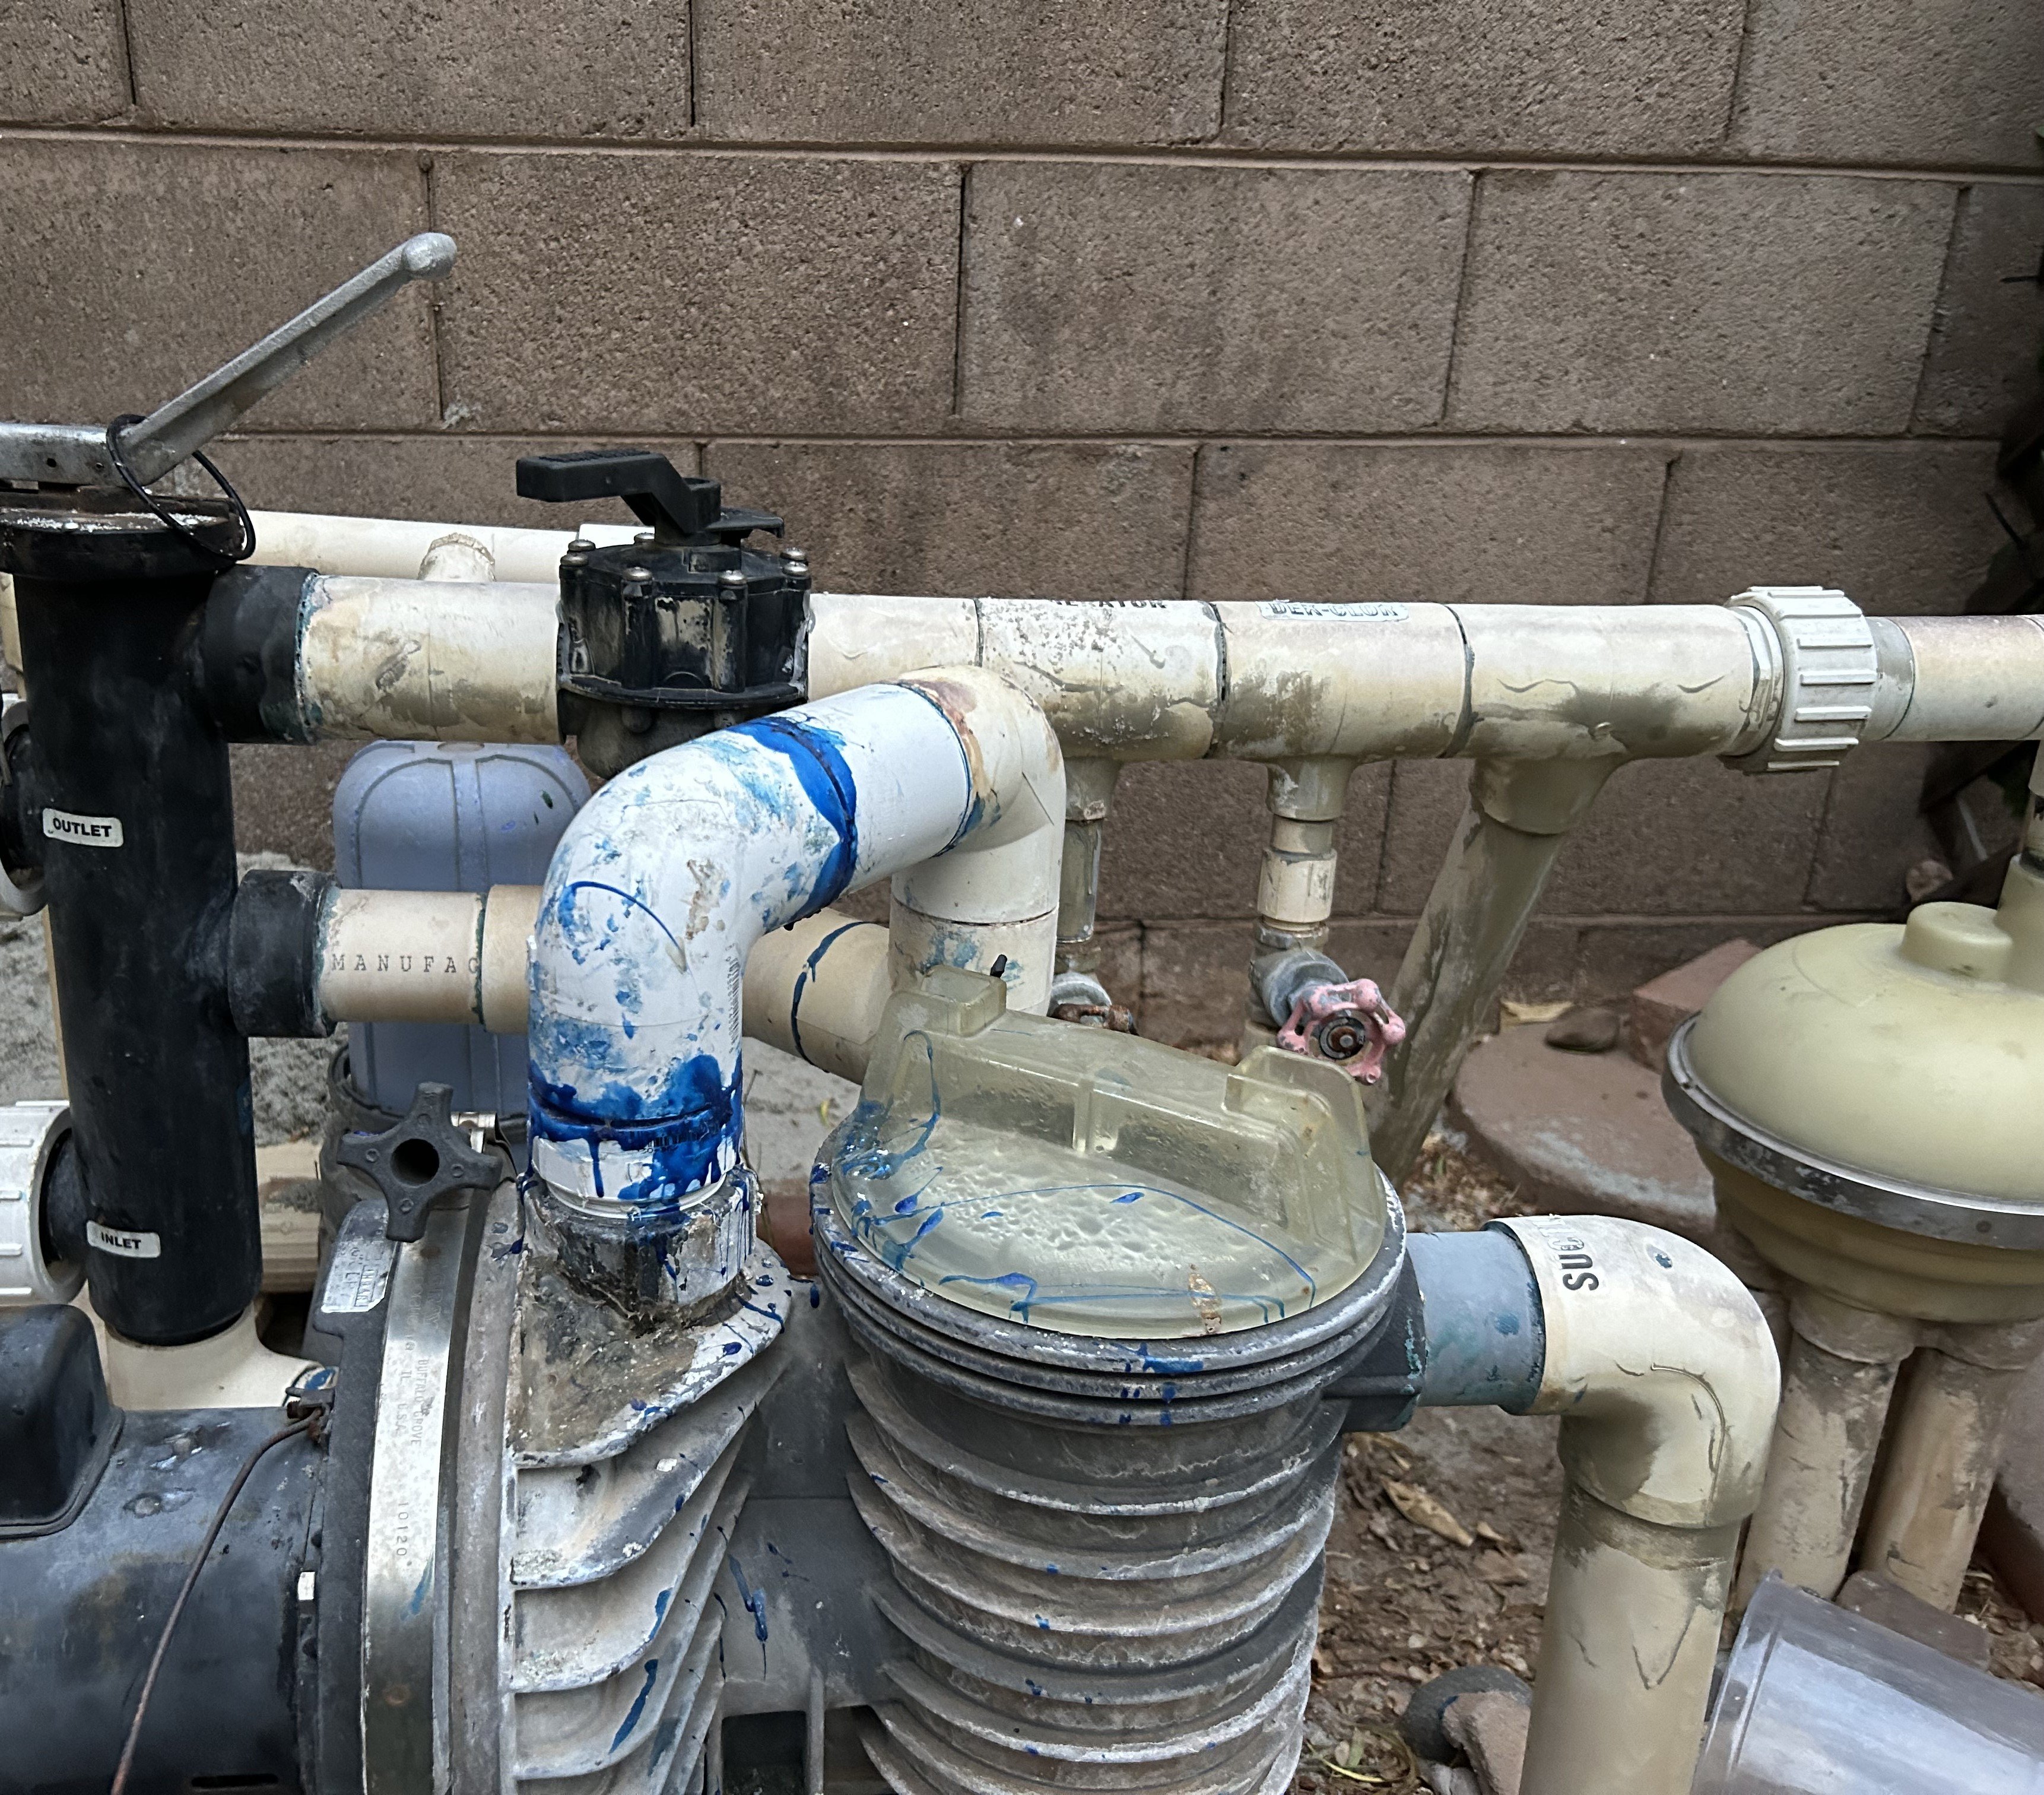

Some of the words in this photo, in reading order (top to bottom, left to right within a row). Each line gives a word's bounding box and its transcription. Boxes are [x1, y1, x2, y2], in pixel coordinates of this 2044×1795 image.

[53, 817, 112, 837] OUTLET
[332, 953, 479, 973] MANUFAC
[101, 1232, 141, 1249] INLET
[414, 1359, 430, 1403] BUFFALO
[410, 1410, 424, 1447] GROVE
[396, 1502, 409, 1556] 10120
